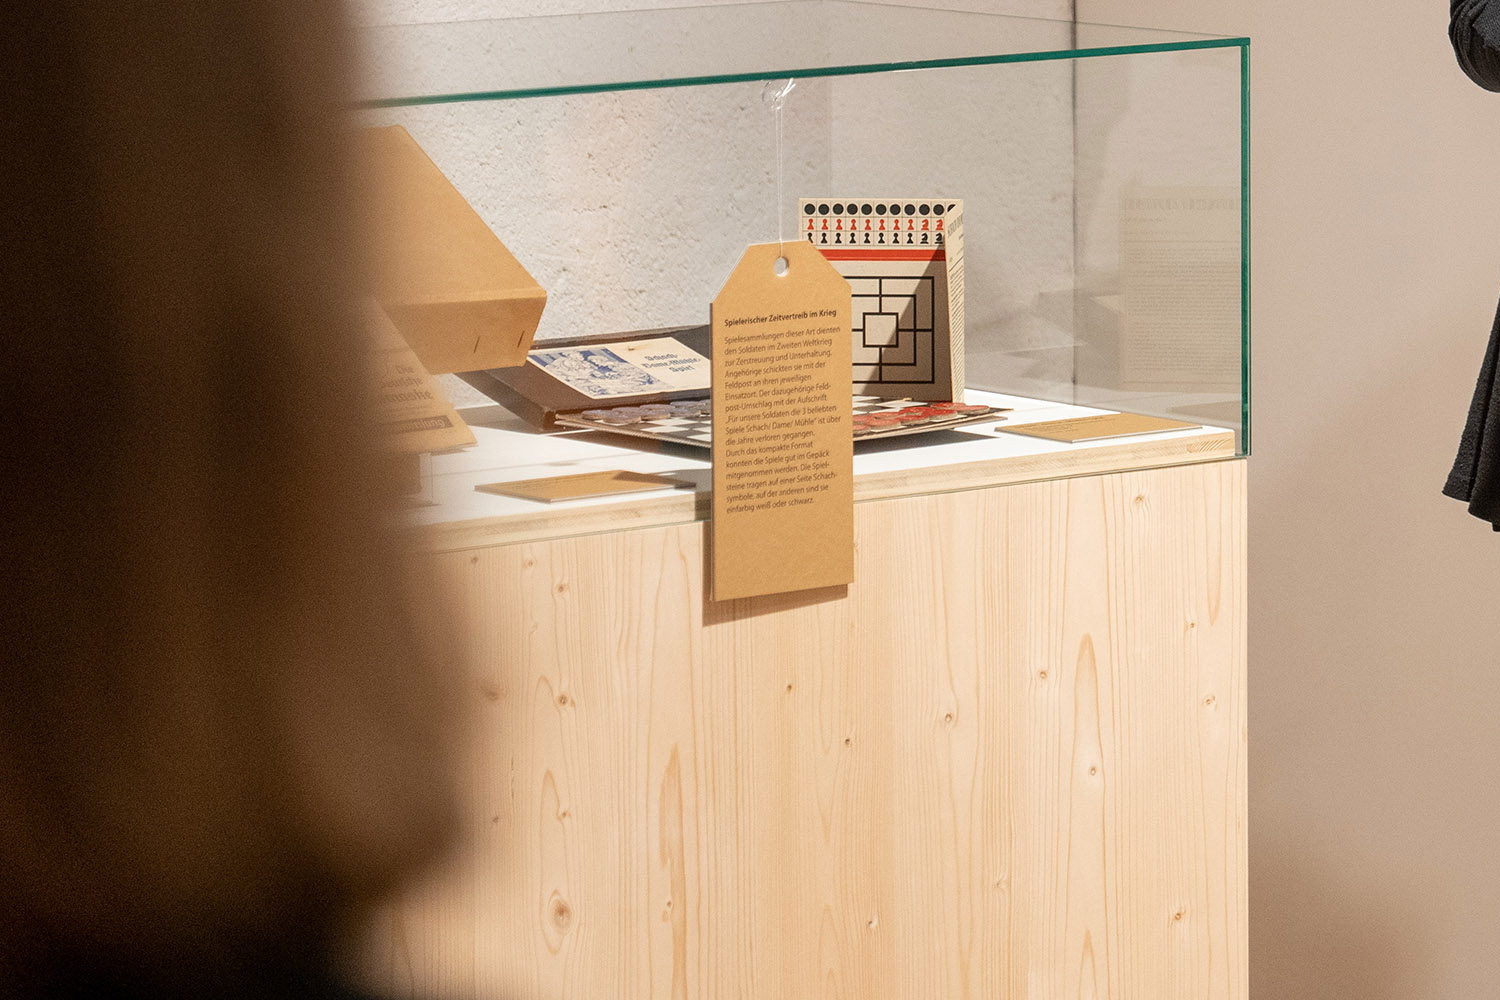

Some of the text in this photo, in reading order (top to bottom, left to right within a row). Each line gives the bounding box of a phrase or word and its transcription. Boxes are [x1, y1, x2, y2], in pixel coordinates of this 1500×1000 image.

[725, 315, 768, 327] Spielerischer
[768, 312, 808, 322] Zeitvertreib
[818, 309, 836, 319] Krieg
[724, 325, 840, 346] Spielesammlungen dieser Art dienten
[724, 347, 738, 355] den
[738, 344, 766, 354] Soldaten
[776, 341, 802, 350] Zweiten
[802, 338, 832, 349] Weltkrieg
[736, 355, 775, 367] Zerstreuung
[775, 354, 789, 362] und
[789, 349, 832, 362] Unterhaltung.
[724, 361, 826, 380] Angehörige schickten sie mit der
[725, 380, 752, 391] Feldpost
[762, 377, 779, 385] ihren
[780, 374, 812, 385] jeweiligen
[725, 383, 831, 401] Einsatzort. Der dazugehörige Feld-
[725, 394, 827, 413] post-Umschlag mit der Aufschrift
[739, 414, 761, 422] unsere
[762, 409, 790, 419] Soldaten
[790, 408, 801, 416] die
[806, 404, 836, 414] beliebten
[725, 425, 745, 436] Spiele
[817, 417, 826, 425] ist
[826, 415, 841, 424] über
[737, 436, 754, 444] Jahre
[755, 433, 781, 443] verloren
[782, 432, 815, 442] gegangen.
[726, 441, 813, 457] Durch das kompakte Format
[726, 458, 753, 468] konnten
[753, 457, 764, 465] die
[764, 455, 784, 466] Spiele
[784, 454, 796, 463] gut
[806, 450, 830, 461] Gepäck
[726, 468, 773, 481] mitgenommen
[774, 465, 799, 474] werden.
[800, 464, 812, 472] Die
[726, 471, 838, 491] steine tragen auf einer Seite Schach-
[755, 491, 766, 499] auf
[766, 490, 778, 498] der
[778, 486, 805, 496] anderen
[806, 485, 820, 493] sind
[820, 484, 829, 492] sie
[726, 497, 814, 515] einfarbig weiß oder schwarz.
